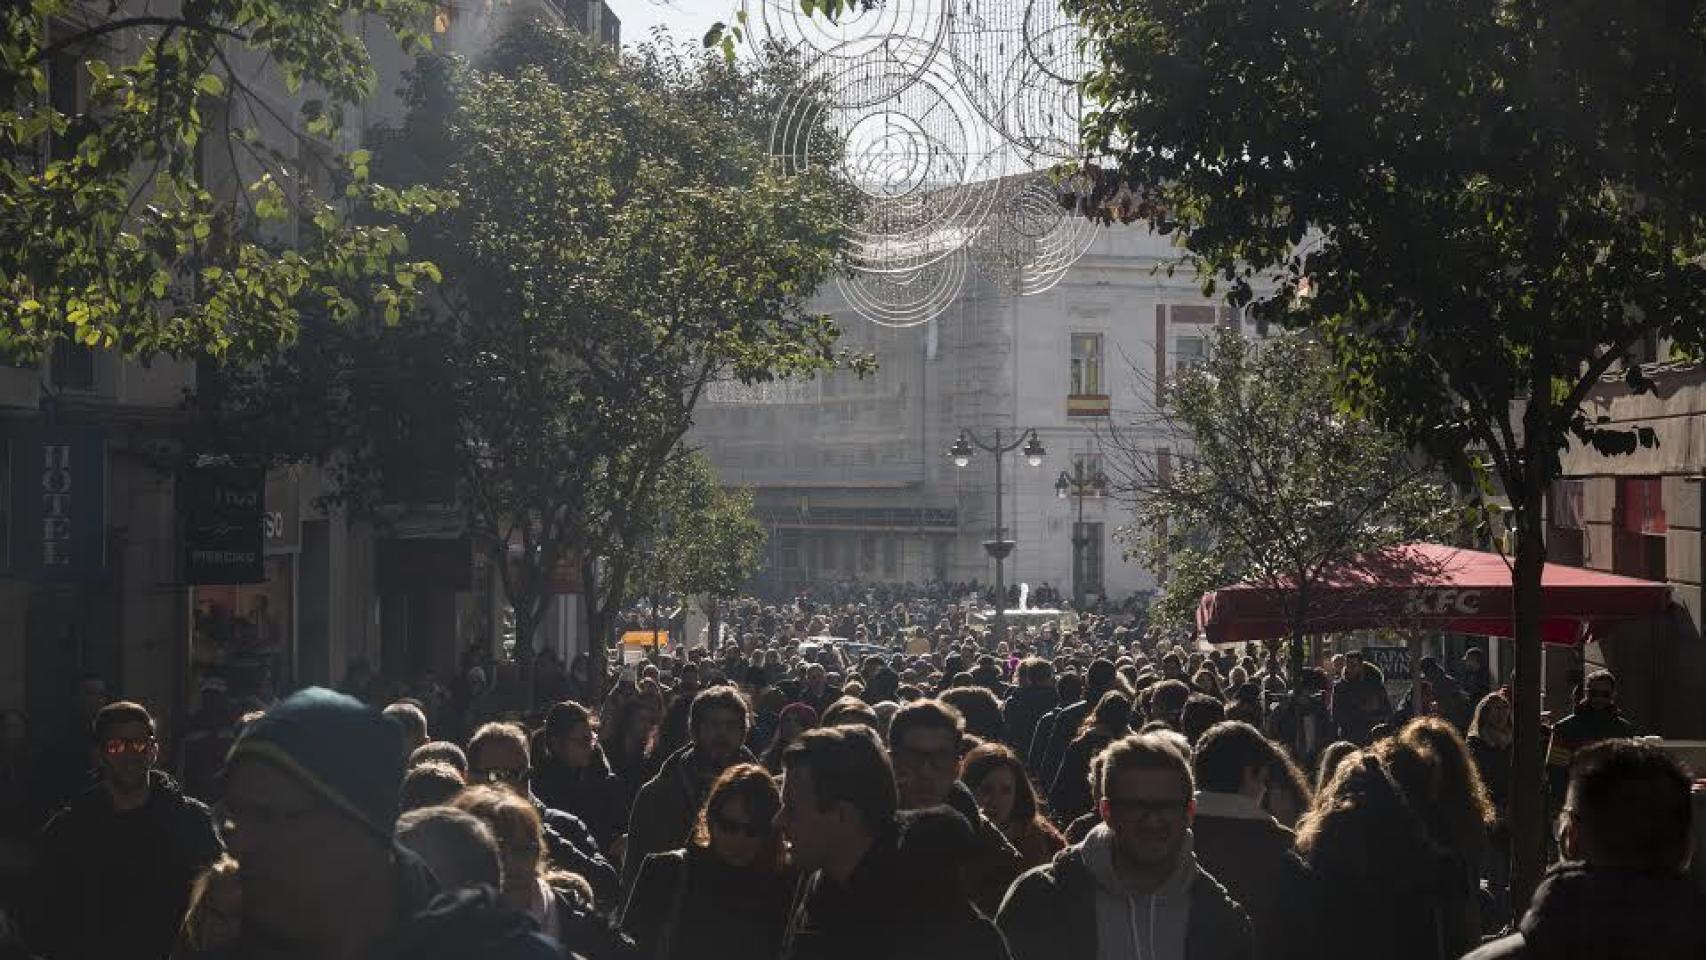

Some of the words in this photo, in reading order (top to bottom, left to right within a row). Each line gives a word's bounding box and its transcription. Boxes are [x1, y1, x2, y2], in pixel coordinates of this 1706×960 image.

[42, 444, 72, 565] HOTEL
[1406, 590, 1480, 614] KFC
[1373, 650, 1412, 662] TAPAS
